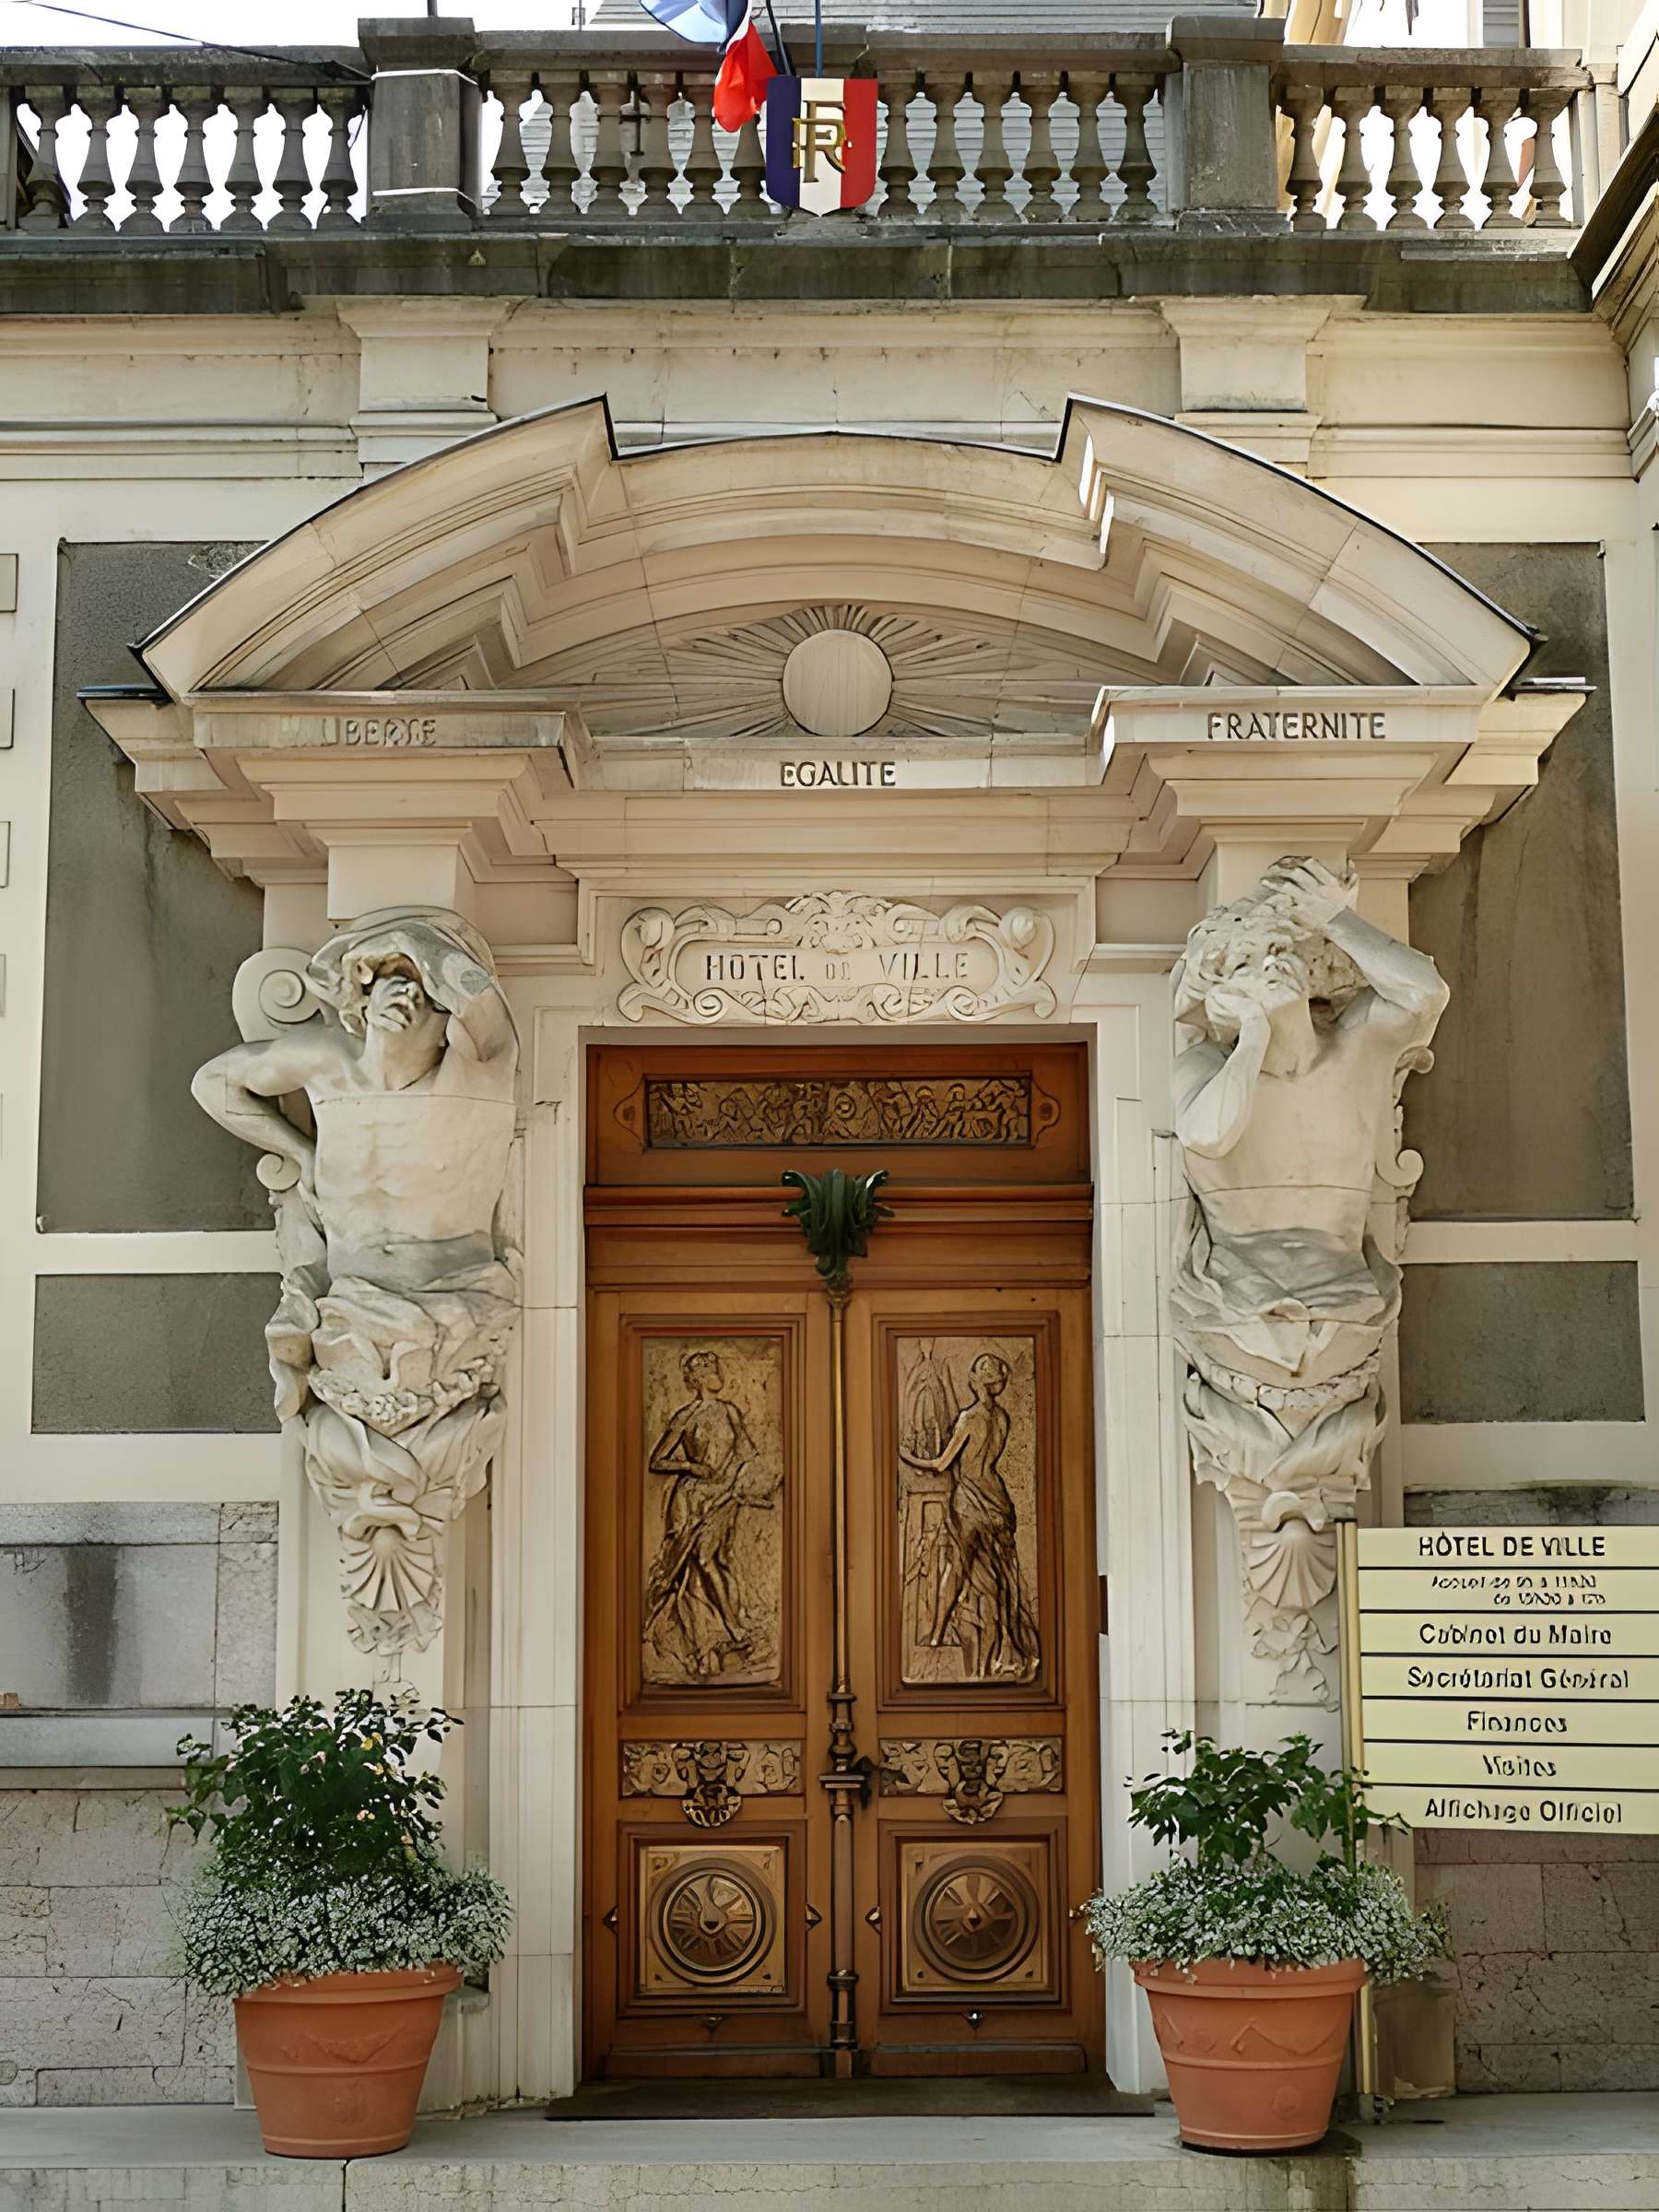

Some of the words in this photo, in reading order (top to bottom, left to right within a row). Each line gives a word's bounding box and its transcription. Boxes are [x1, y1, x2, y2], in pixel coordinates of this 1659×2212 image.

[1208, 712, 1385, 739] FRATERNITE
[781, 761, 895, 786] EGALITE
[878, 951, 969, 981] VILLE
[1504, 1536, 1534, 1556] DE
[1541, 1536, 1605, 1556] VILLE
[1514, 1626, 1540, 1643] du
